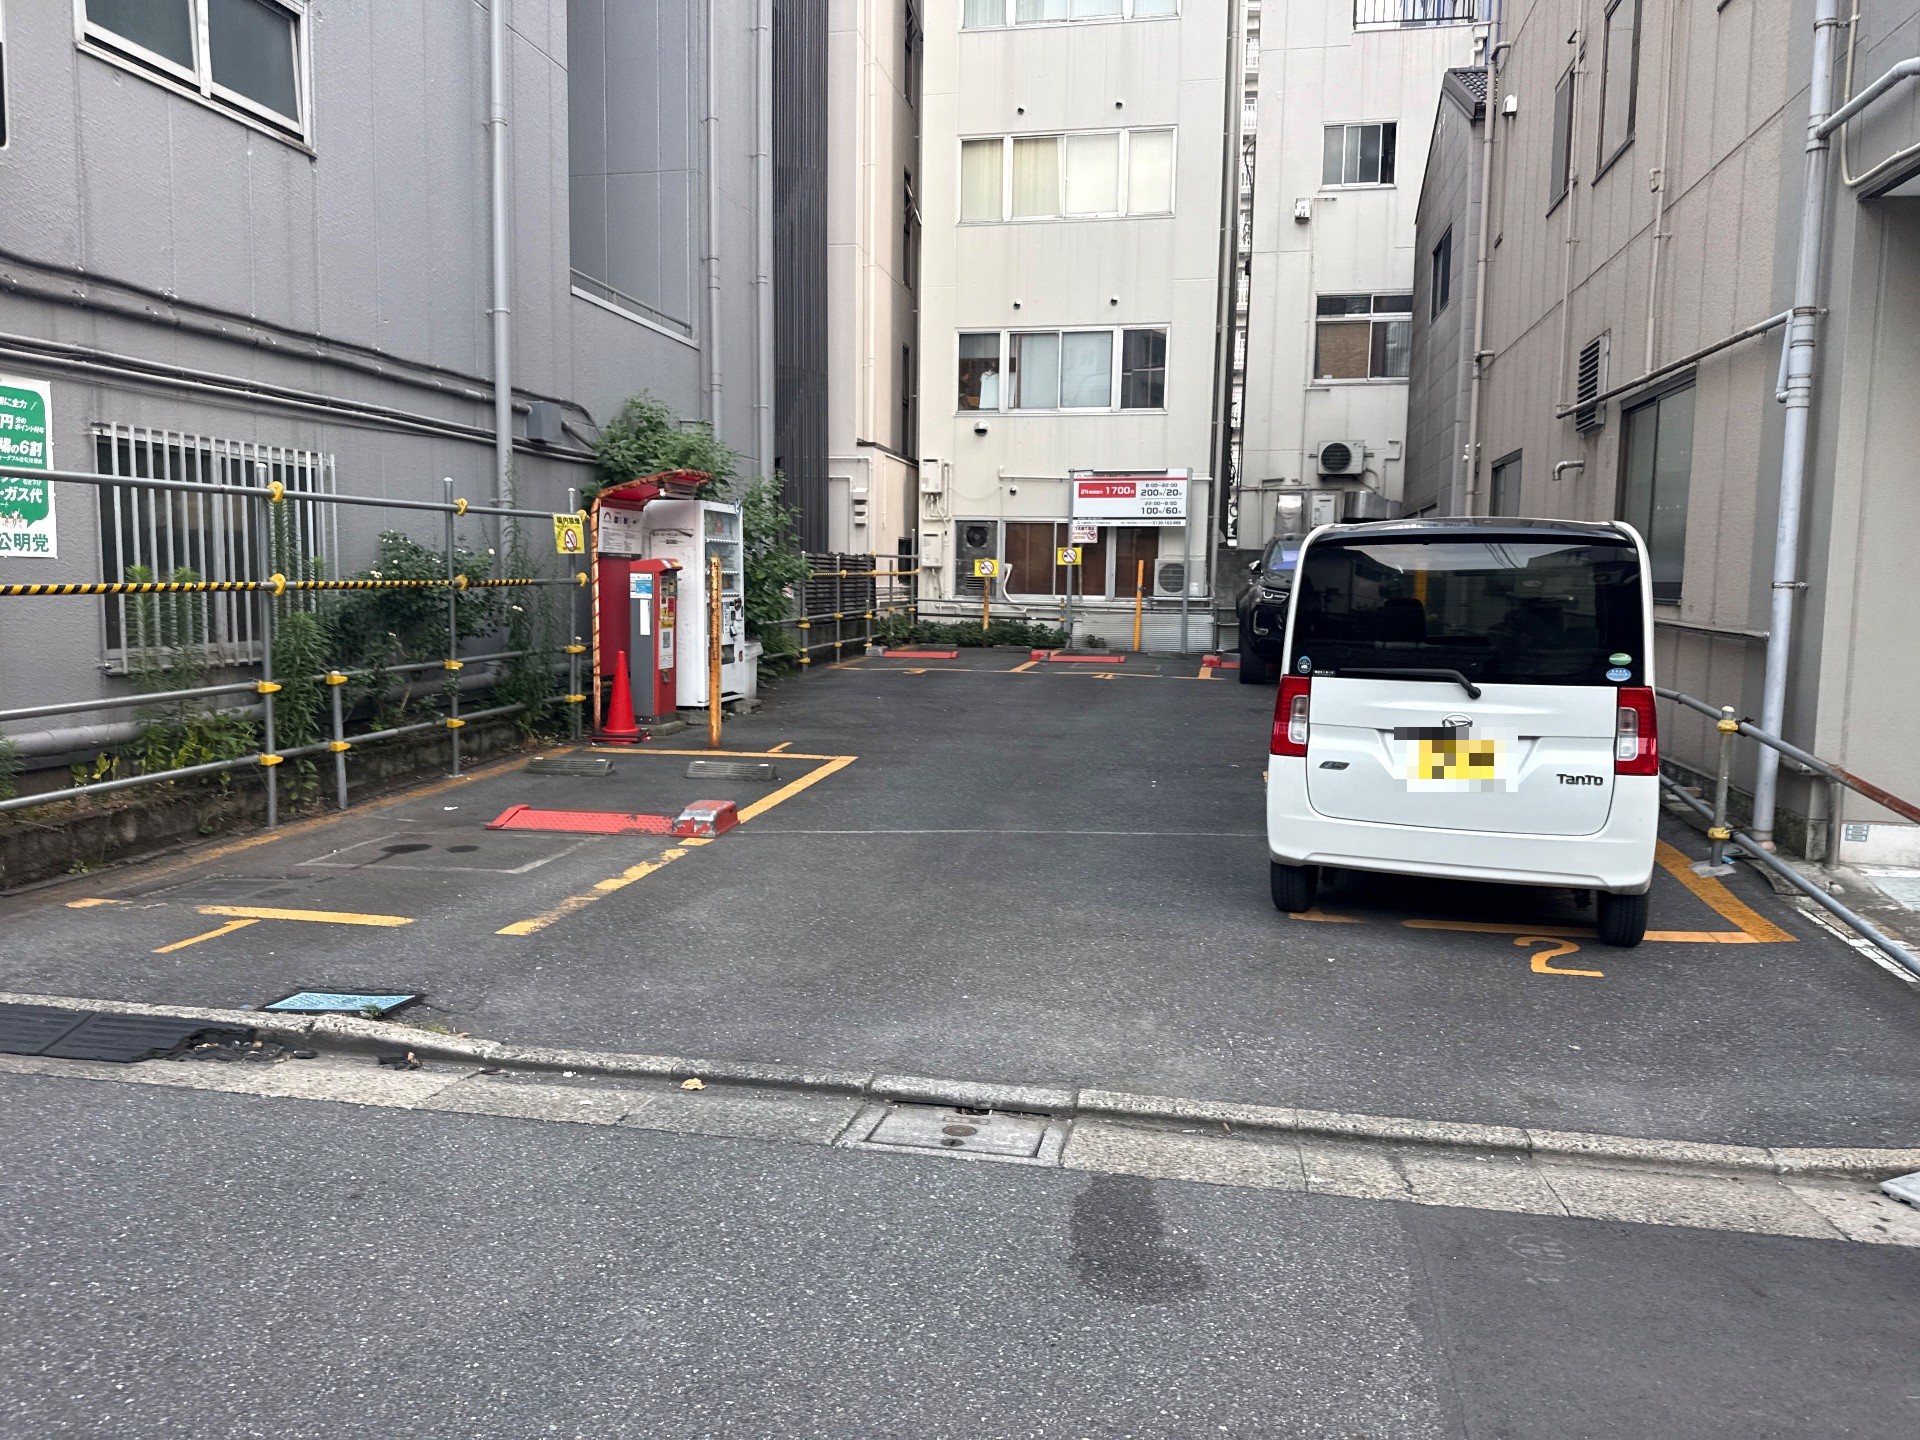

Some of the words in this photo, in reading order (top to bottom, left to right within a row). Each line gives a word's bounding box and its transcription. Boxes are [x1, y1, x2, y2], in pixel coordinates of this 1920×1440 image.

[0, 532, 50, 553] 公明党
[1513, 936, 1605, 978] 2
